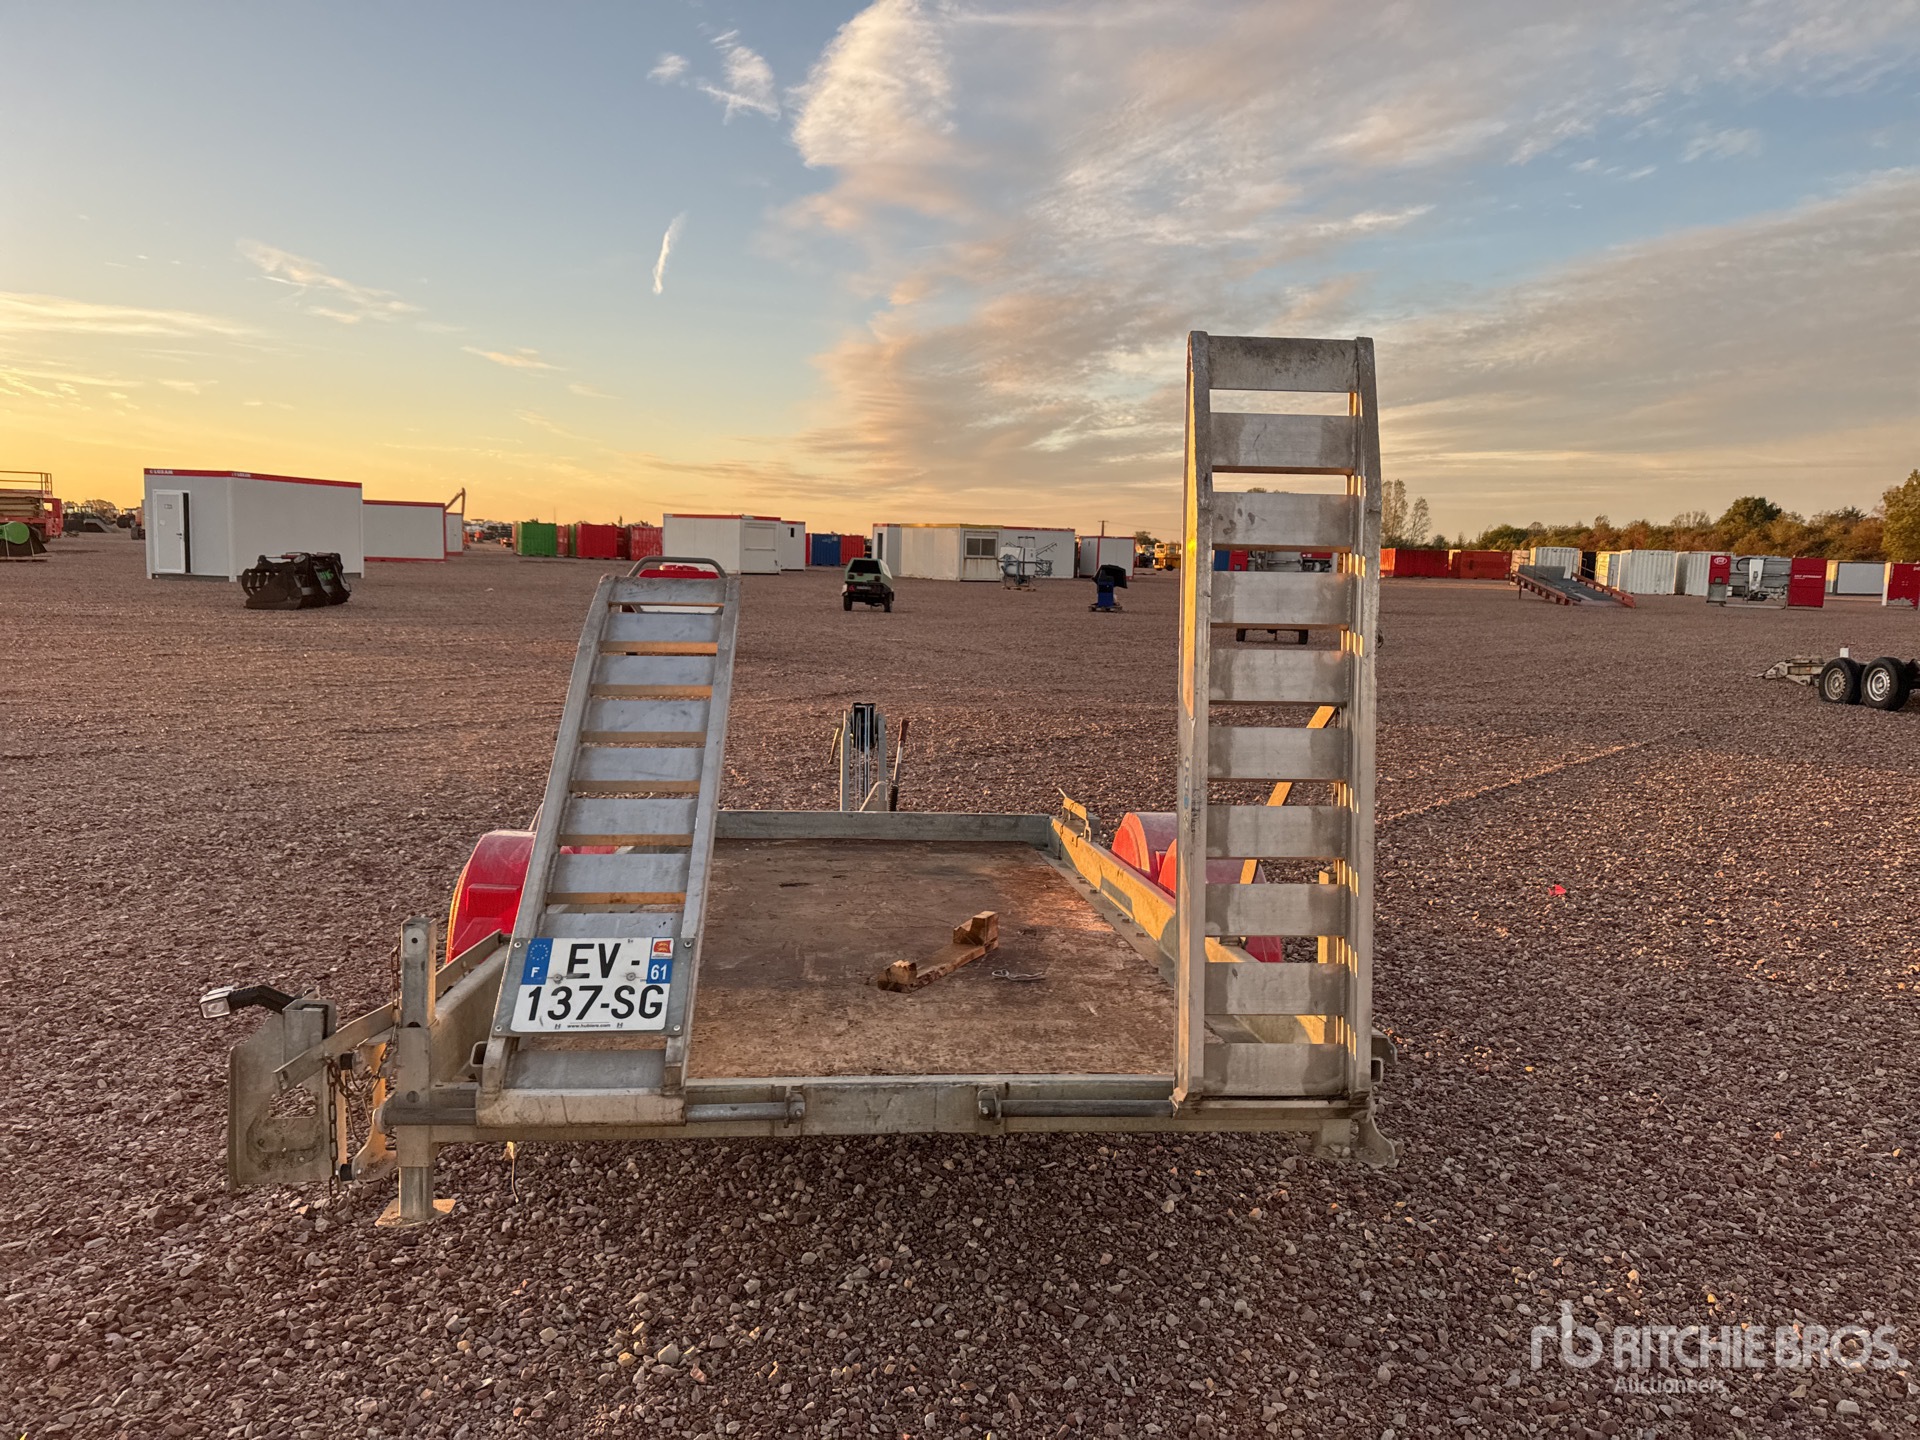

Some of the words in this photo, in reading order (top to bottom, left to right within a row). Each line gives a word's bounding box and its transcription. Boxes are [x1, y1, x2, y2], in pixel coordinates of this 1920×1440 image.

[531, 967, 540, 977] F
[650, 965, 668, 980] 61
[528, 984, 664, 1021] 137-SG
